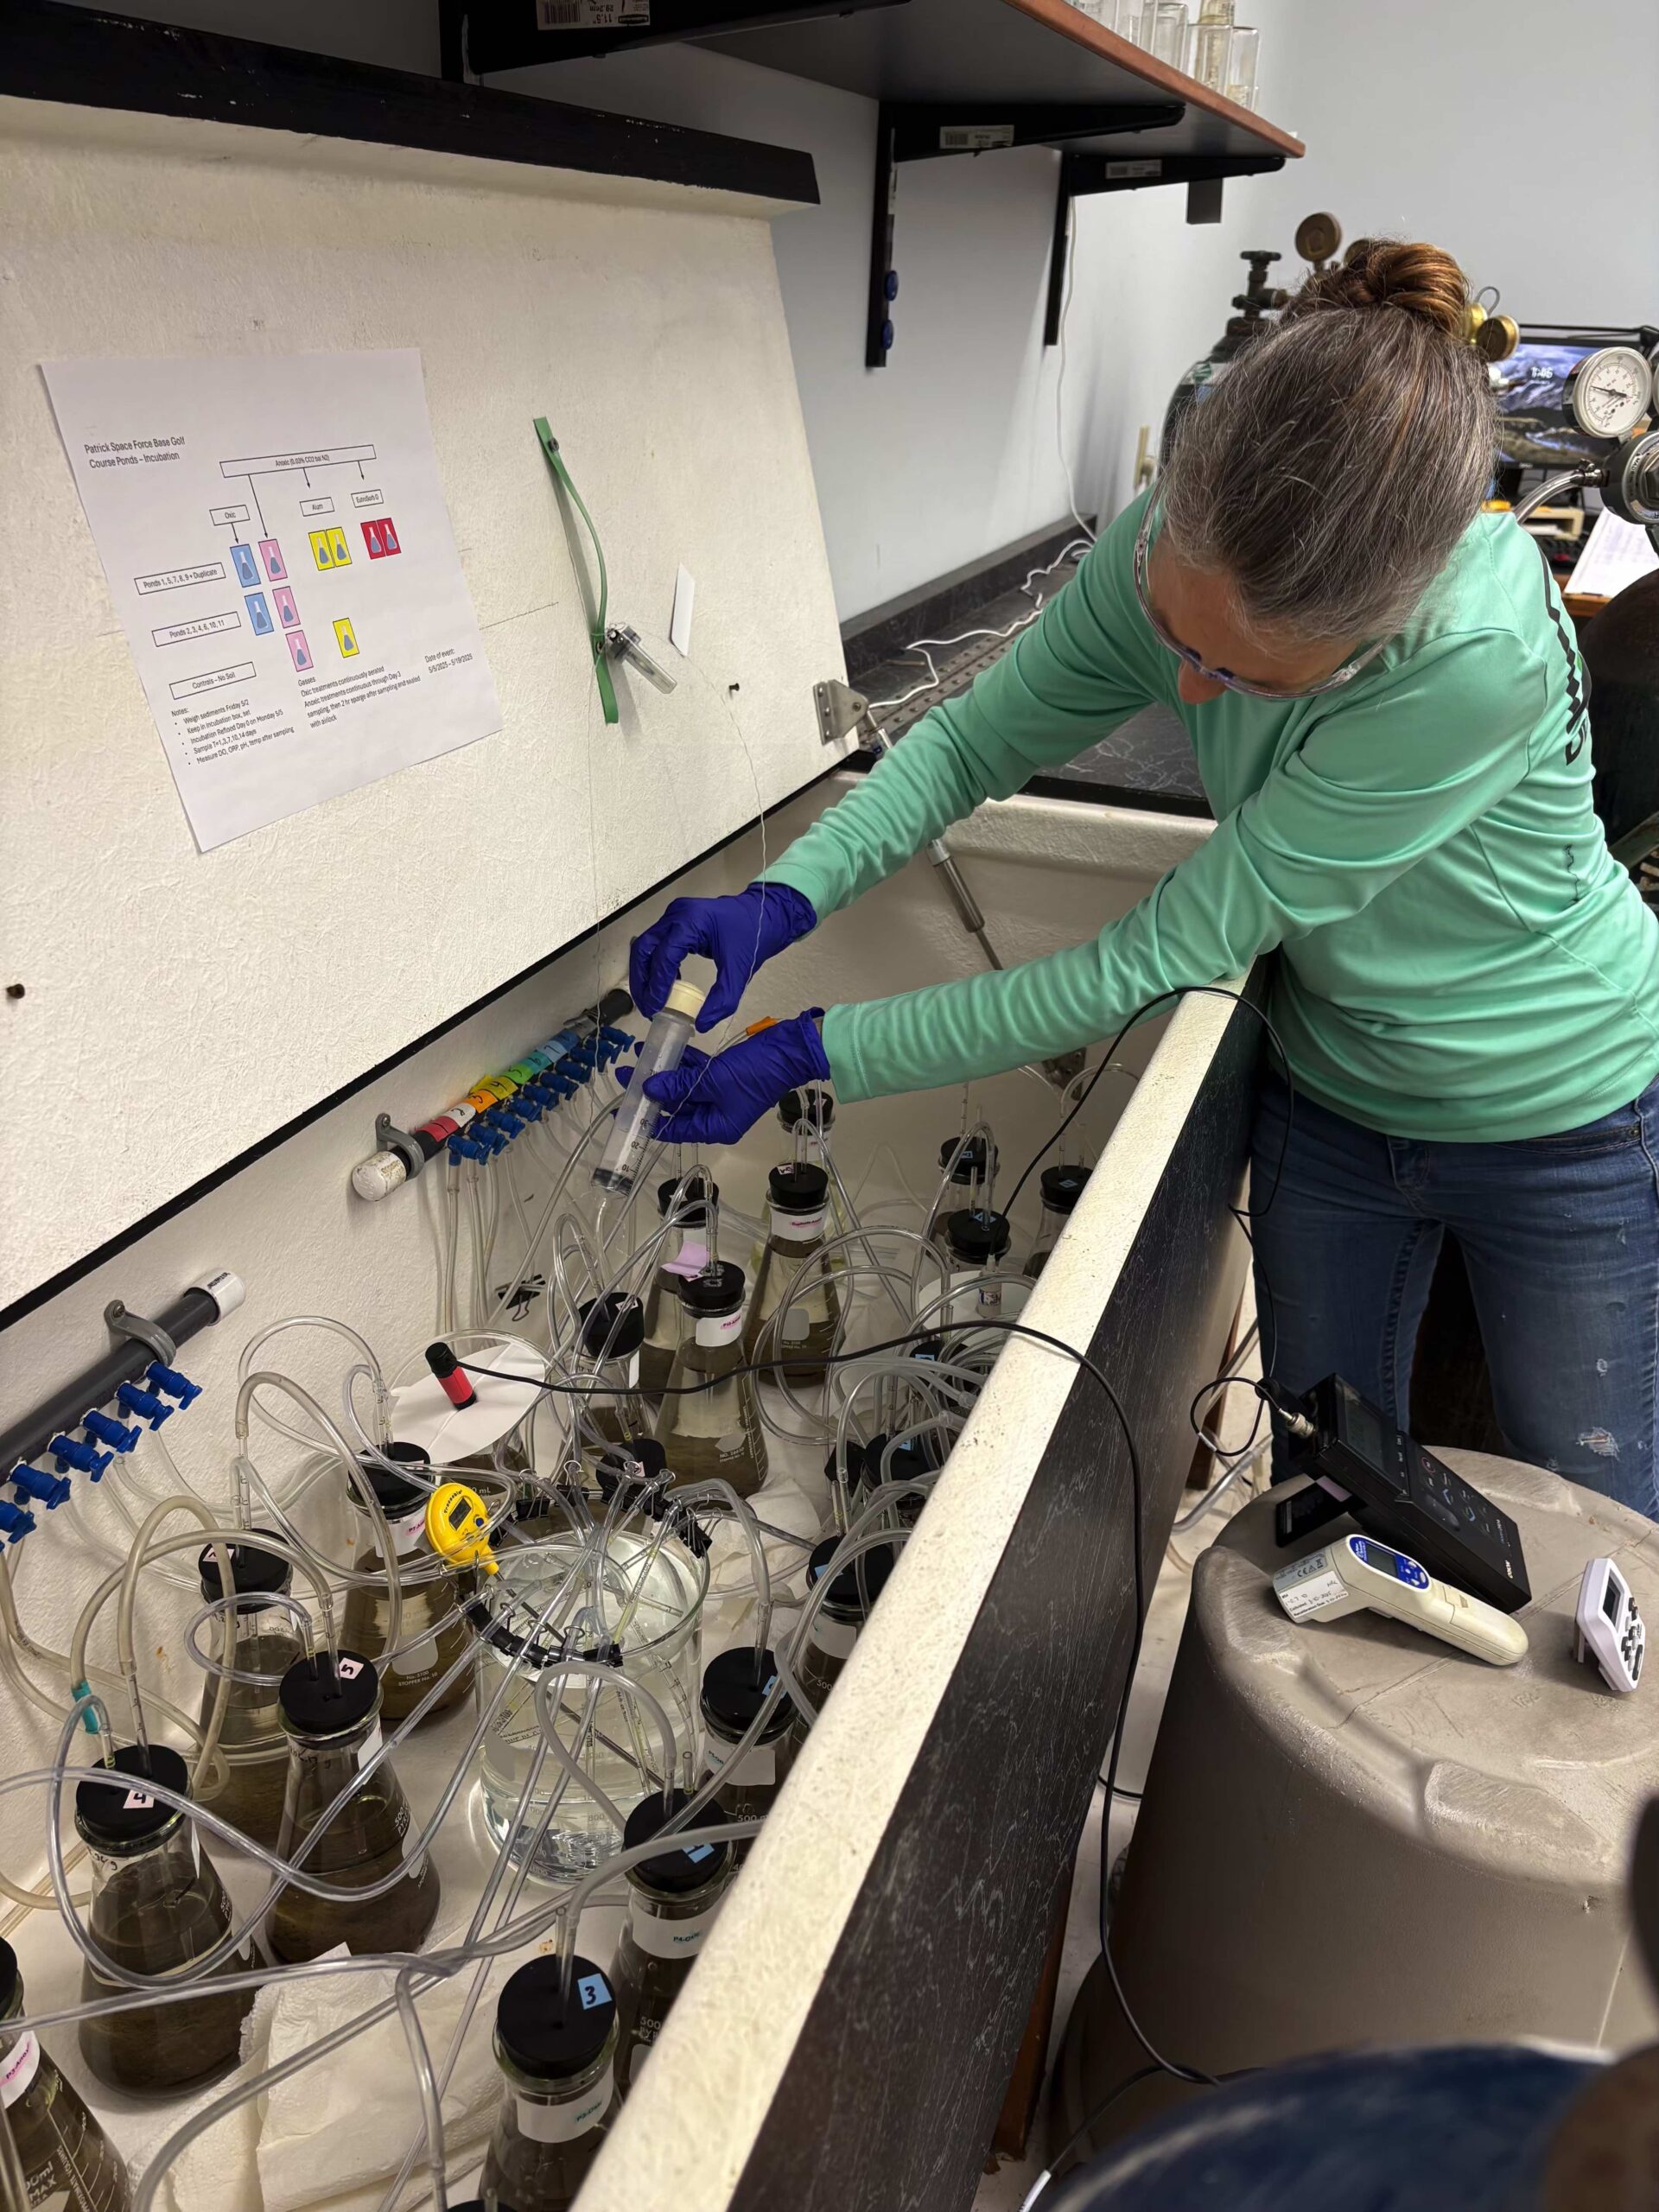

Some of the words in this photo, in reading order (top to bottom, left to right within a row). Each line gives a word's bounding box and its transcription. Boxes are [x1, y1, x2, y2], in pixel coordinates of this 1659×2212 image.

[84, 442, 109, 454] Patrick
[111, 442, 132, 452] Space
[133, 440, 153, 449] Force
[153, 438, 170, 448] Base
[171, 436, 185, 445] Golf
[89, 459, 116, 468] Course
[116, 455, 138, 466] Ponds
[143, 452, 180, 462] Incubation
[143, 579, 161, 588] Ponds
[194, 569, 217, 579] Duplicate
[169, 629, 186, 639] Ponds
[442, 648, 454, 658] event:
[193, 677, 213, 689] Controls
[298, 677, 315, 687] Gasses
[301, 689, 312, 697] Oxic
[312, 682, 338, 693] treatments
[304, 698, 320, 708] Anoxic
[321, 690, 346, 702] treatments
[346, 682, 372, 694] continuous
[372, 676, 389, 686] through
[351, 694, 366, 704] sparge
[378, 685, 397, 696] sampling
[406, 676, 421, 684] sealed
[171, 708, 189, 717] Notes:
[183, 715, 200, 724] Weigh
[200, 707, 226, 719] sediments
[226, 702, 241, 712] Friday
[187, 725, 200, 734] Keep
[207, 715, 232, 728] incubation
[310, 720, 321, 728] with
[321, 714, 337, 724] airlock
[190, 730, 217, 745] Incubation
[217, 724, 236, 734] Reflood
[236, 722, 246, 731] Day
[257, 713, 276, 722] Monday
[194, 743, 213, 754] Sample
[245, 728, 257, 737] days
[197, 753, 218, 764] Measure
[249, 737, 262, 747] temp
[273, 727, 295, 738] sampling
[632, 1141, 639, 1150] 20
[341, 1664, 354, 1675] 5
[133, 1792, 146, 1804] 4
[585, 1986, 596, 2005] 3
[640, 2016, 661, 2030] 500
